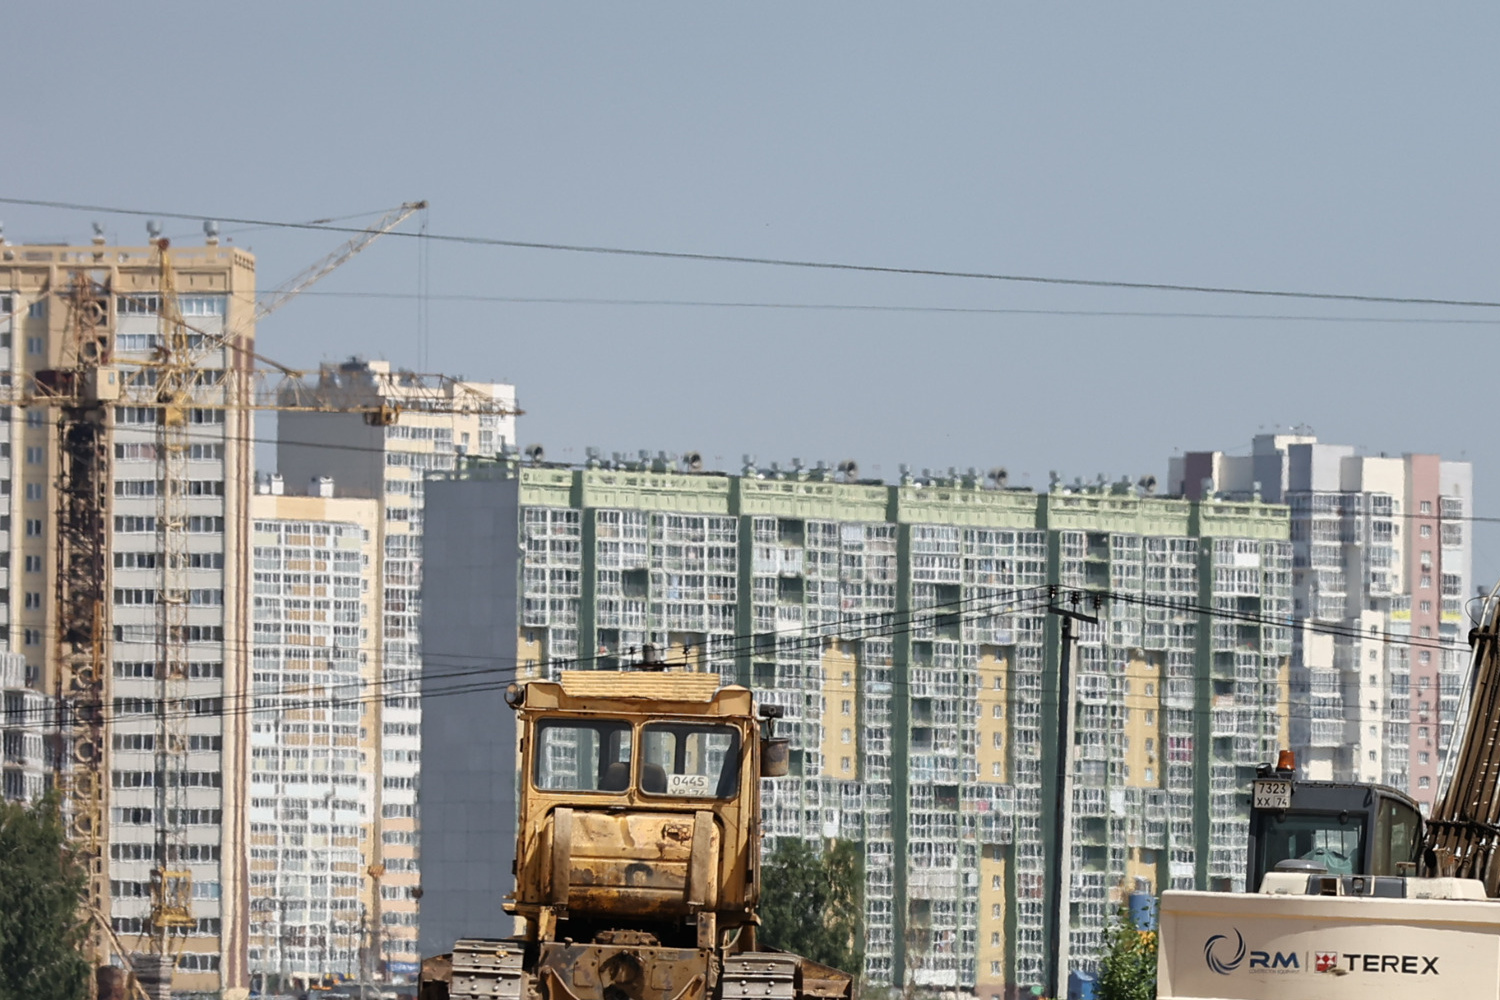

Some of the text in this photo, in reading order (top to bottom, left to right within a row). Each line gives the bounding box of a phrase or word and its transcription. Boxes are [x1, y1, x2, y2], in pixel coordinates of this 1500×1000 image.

[672, 776, 705, 787] 0445
[1259, 783, 1286, 794] 7323
[1257, 797, 1287, 806] XX 74
[1250, 951, 1440, 975] RM TEREX
